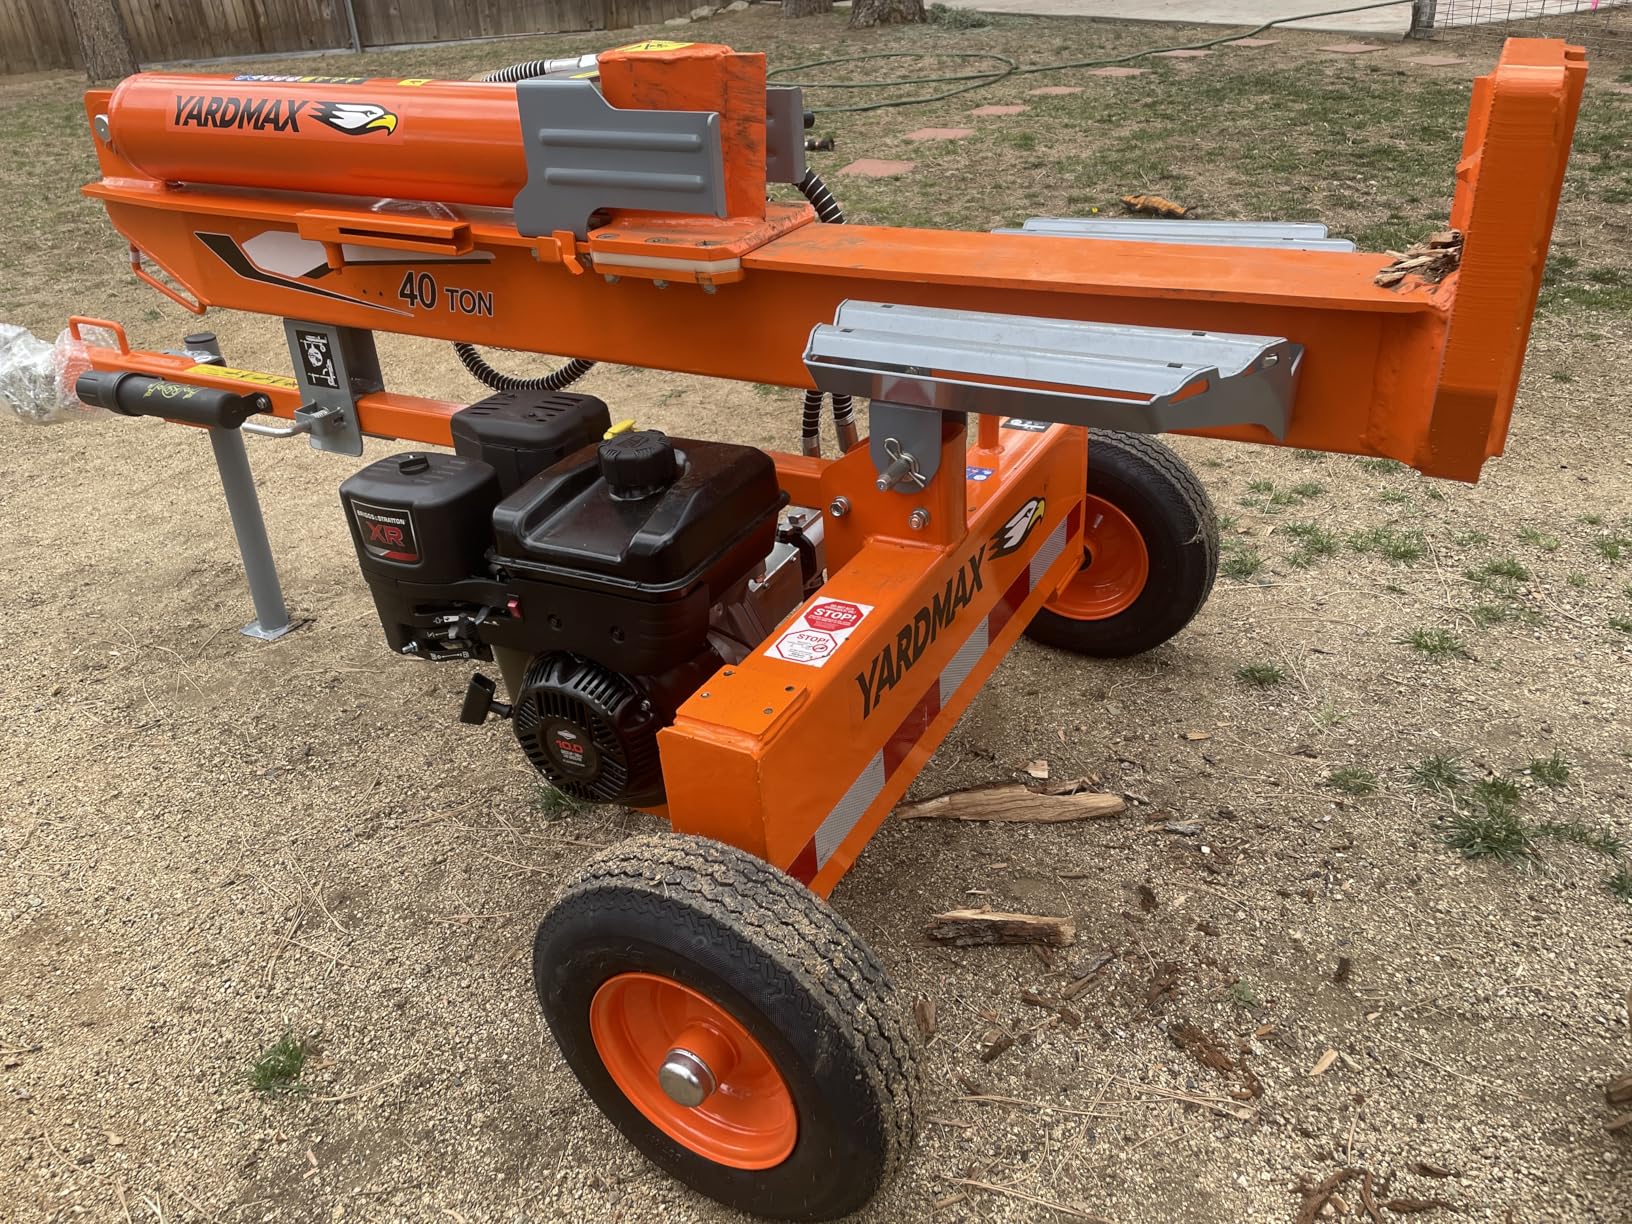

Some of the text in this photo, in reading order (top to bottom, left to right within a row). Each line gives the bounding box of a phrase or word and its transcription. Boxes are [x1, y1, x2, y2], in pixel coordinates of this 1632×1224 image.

[174, 95, 309, 133] YARDMAX
[398, 270, 494, 317] 40 TON
[366, 521, 406, 548] XR
[813, 608, 857, 622] STOP!
[796, 633, 830, 645] STOP!
[854, 542, 987, 721] YARDMAX
